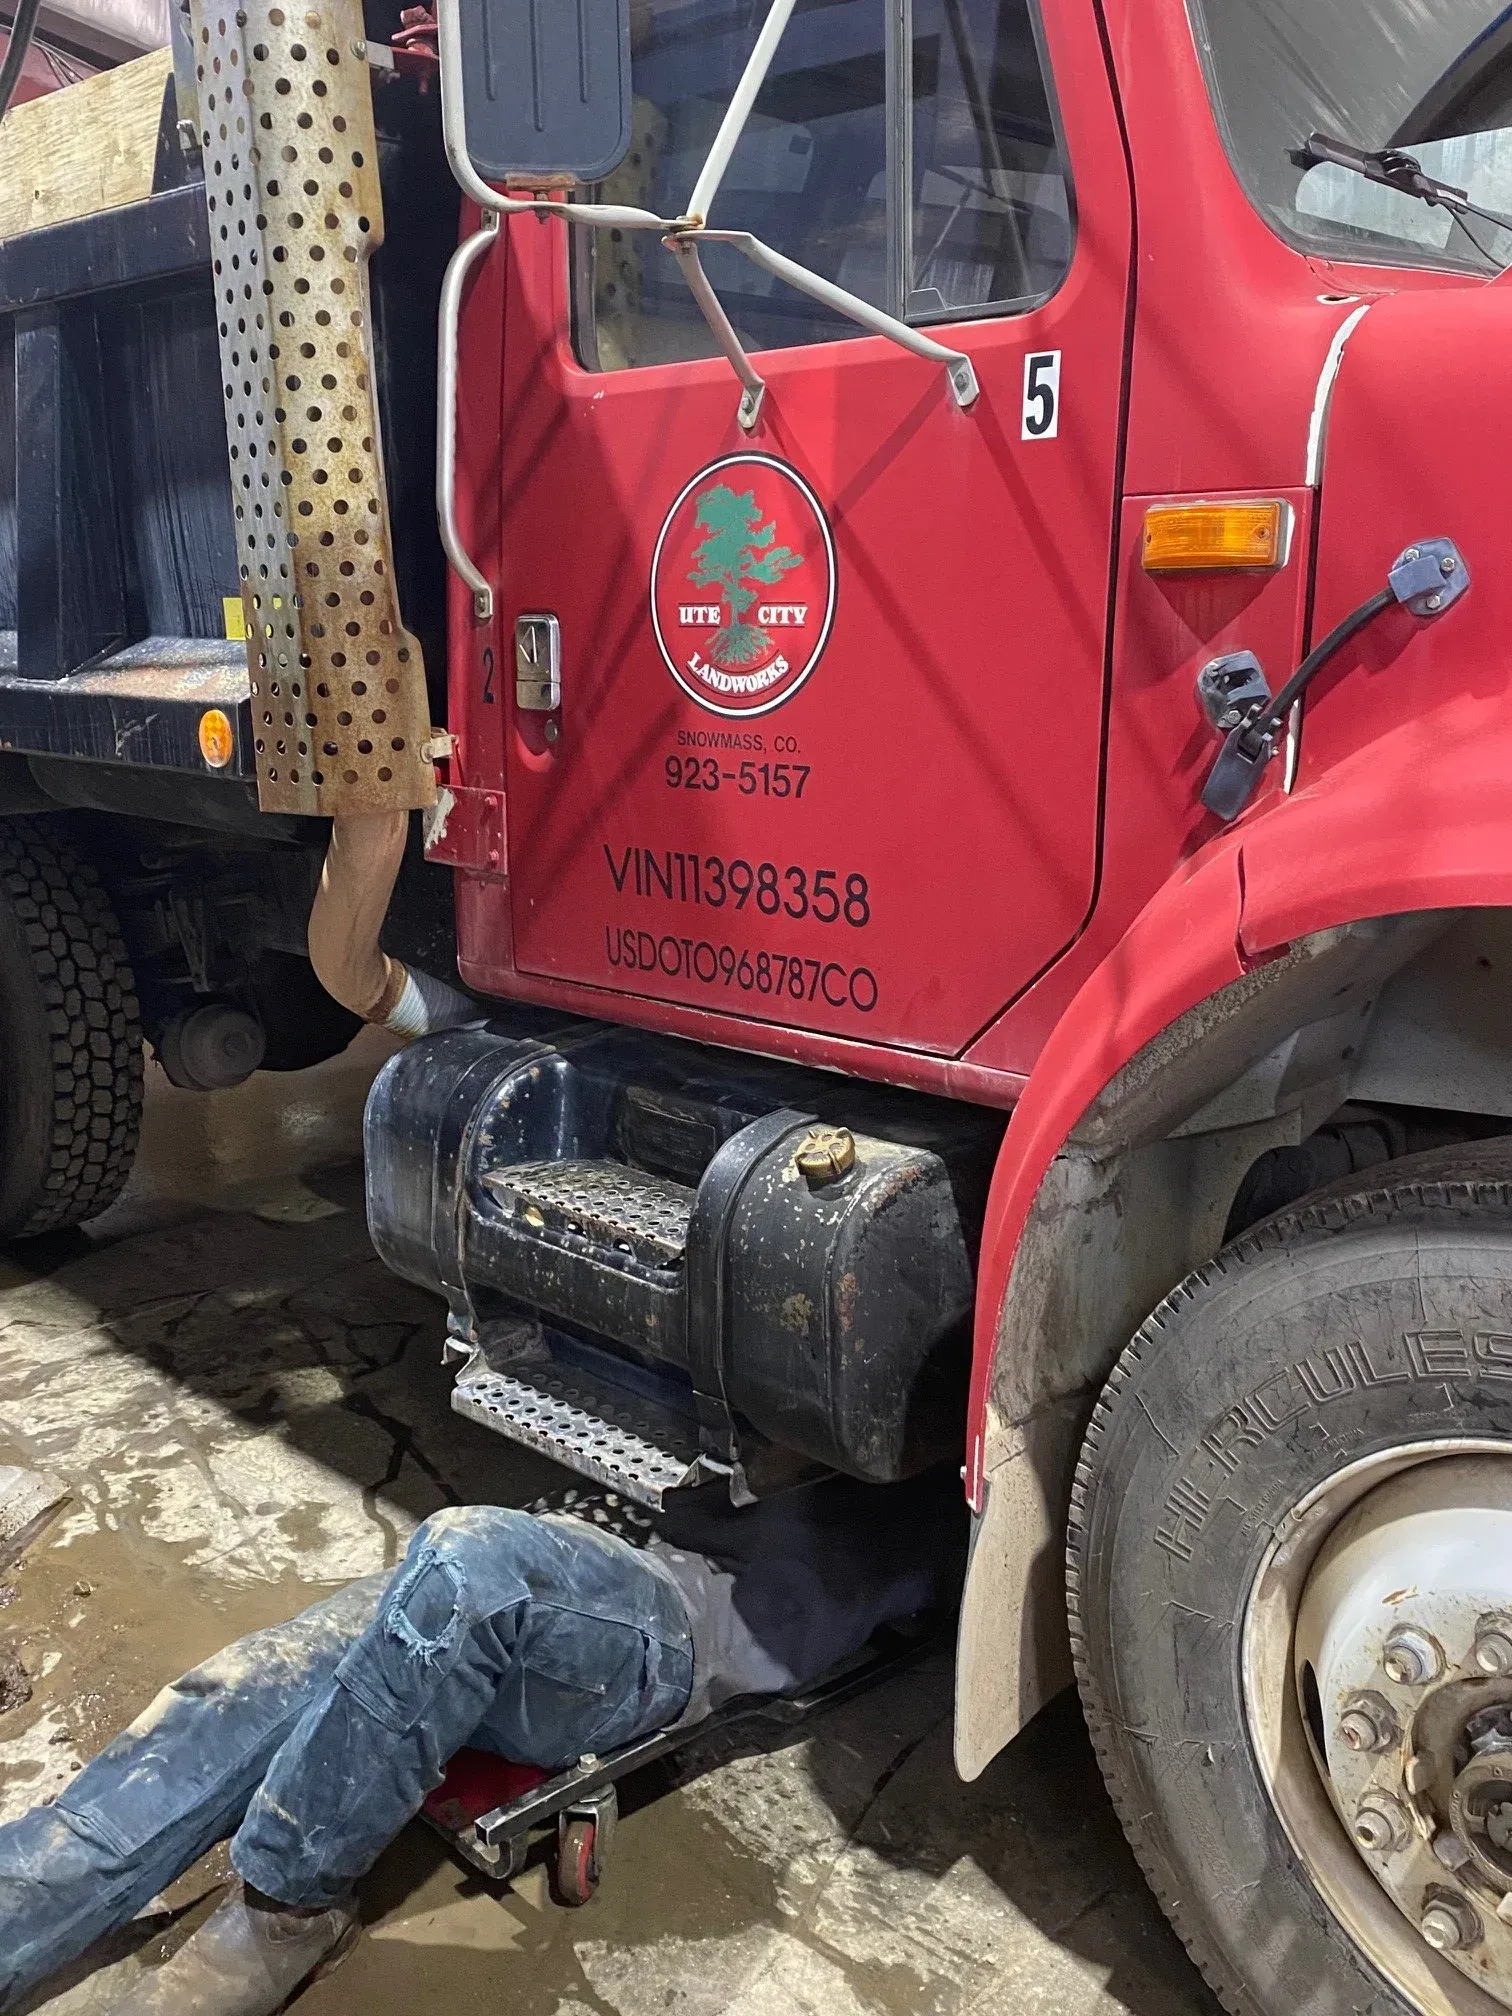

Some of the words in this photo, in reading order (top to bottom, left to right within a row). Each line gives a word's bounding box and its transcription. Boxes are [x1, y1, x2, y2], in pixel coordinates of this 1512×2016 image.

[1026, 355, 1054, 435] 5
[679, 606, 720, 625] UTE
[758, 606, 808, 625] CITY
[687, 652, 790, 693] LANDWORKS
[677, 730, 767, 754] SNOWMASS,
[774, 735, 802, 754] CO.
[664, 755, 811, 799] 923-5157
[603, 844, 871, 928] VIN11398358
